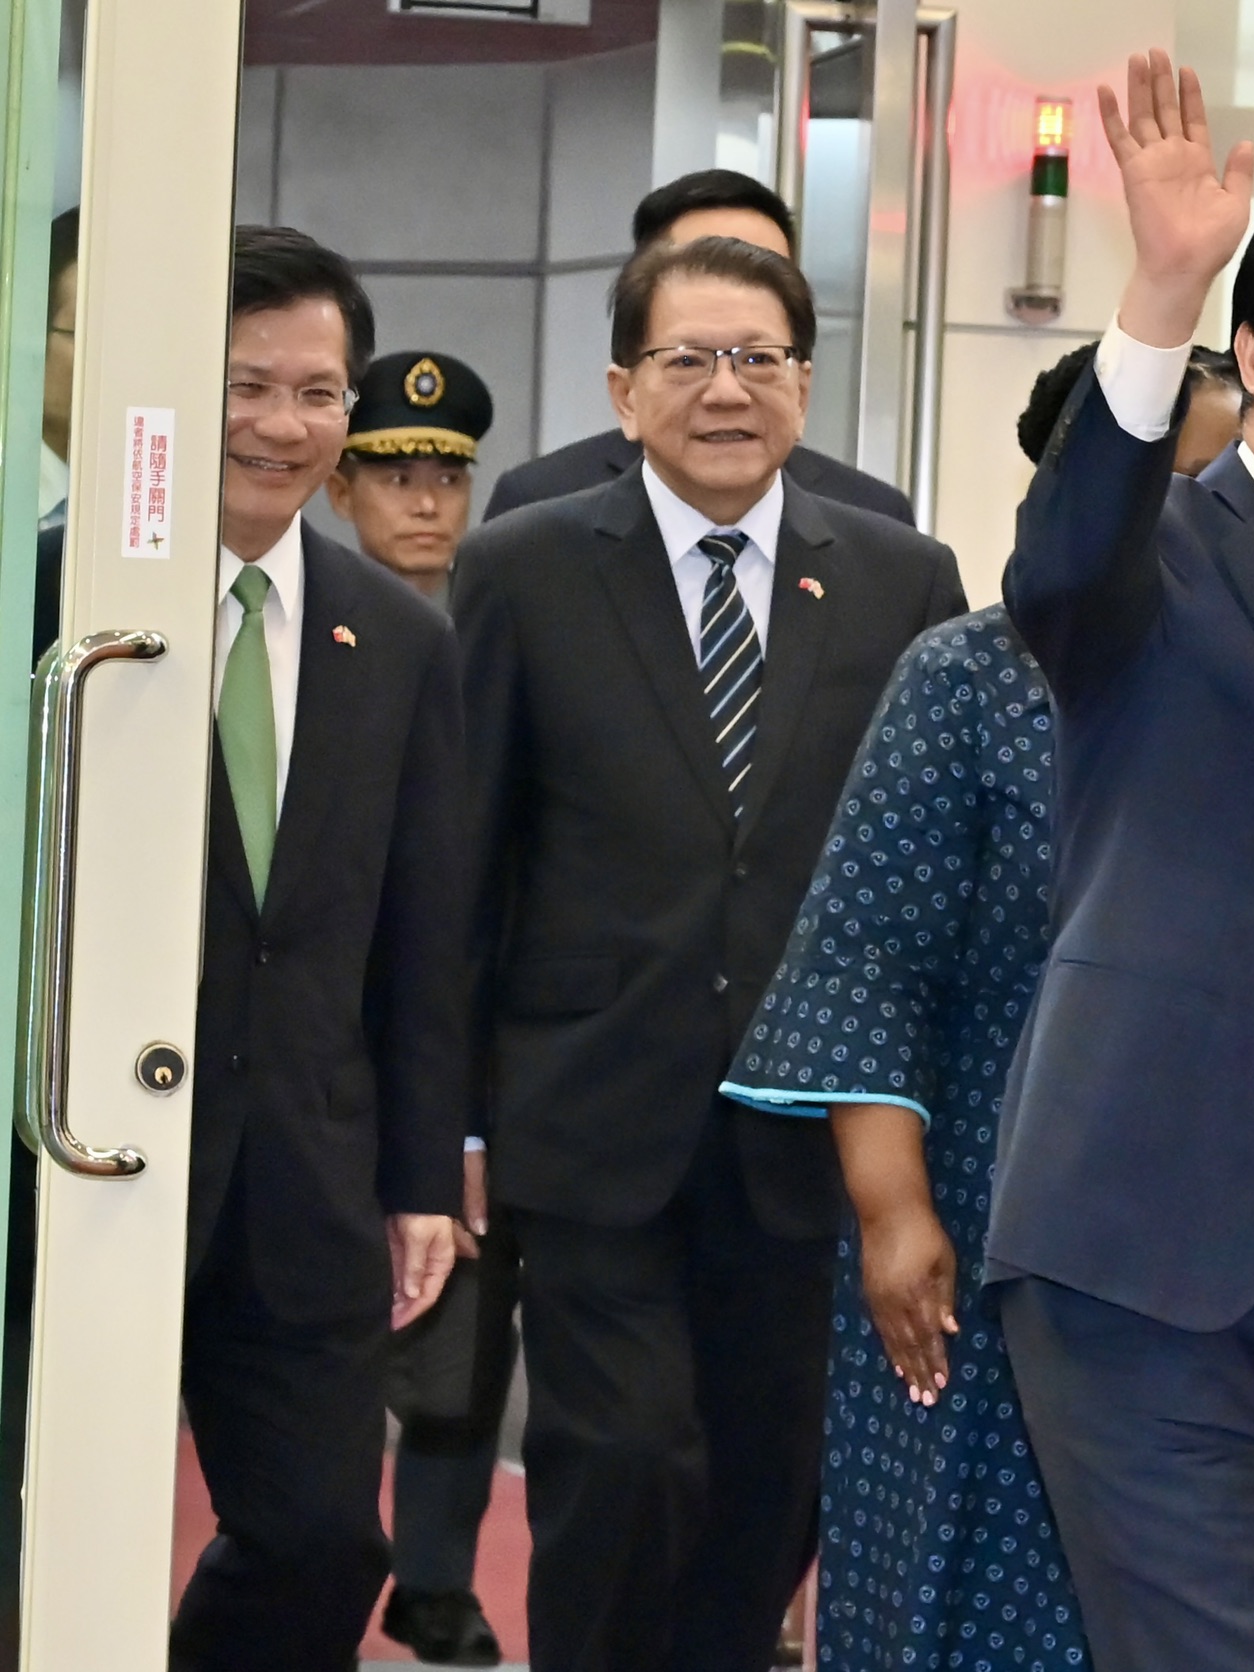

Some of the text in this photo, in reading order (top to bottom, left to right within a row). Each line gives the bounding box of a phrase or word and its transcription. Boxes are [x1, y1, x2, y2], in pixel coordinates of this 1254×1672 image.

[148, 435, 167, 522] 請隨手關門
